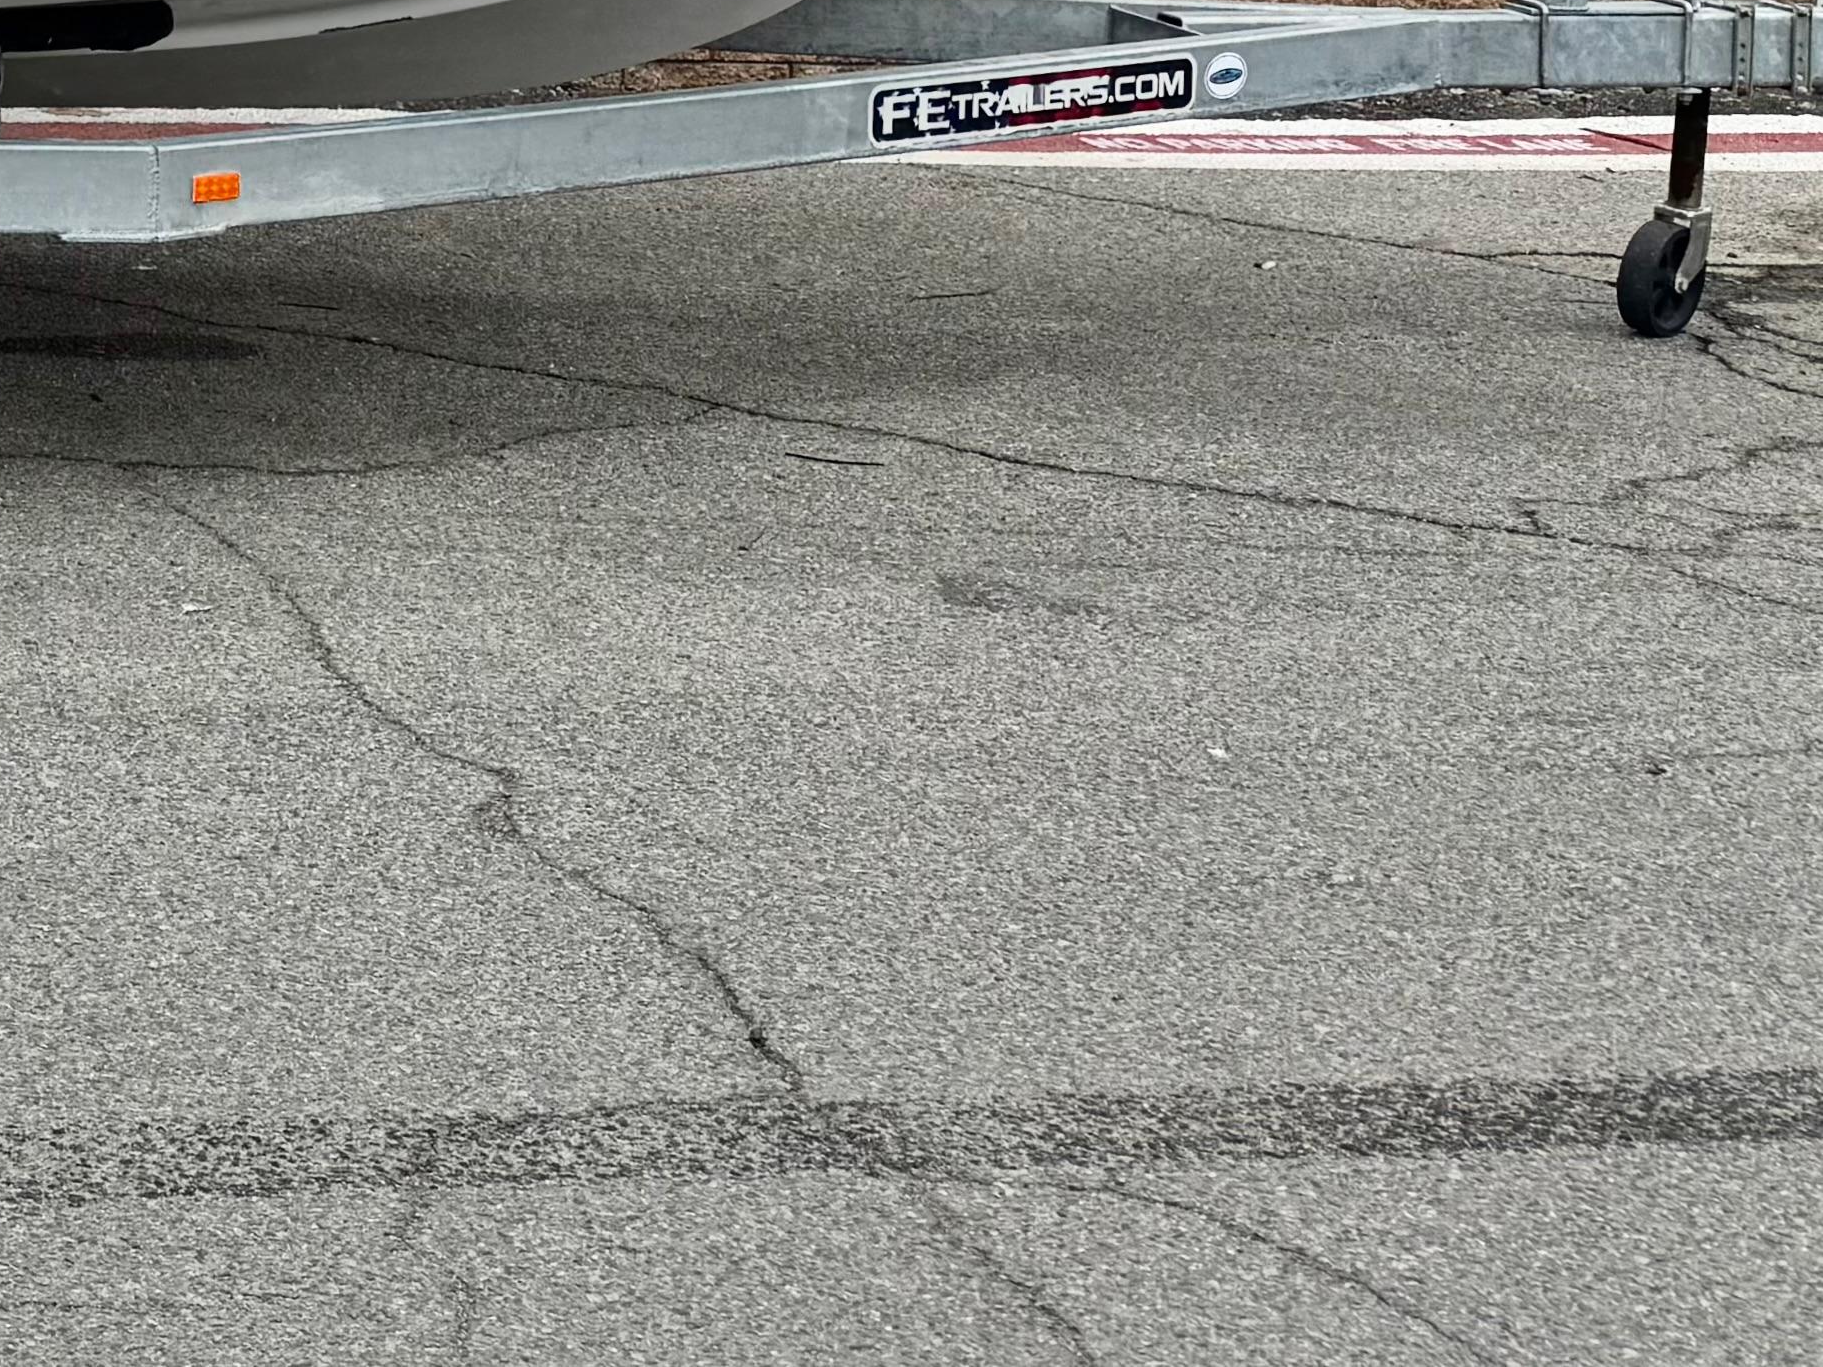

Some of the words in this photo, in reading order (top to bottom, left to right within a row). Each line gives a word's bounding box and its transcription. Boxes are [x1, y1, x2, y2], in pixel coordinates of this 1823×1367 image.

[1079, 137, 1165, 151] NO
[1156, 138, 1362, 152] PARKING
[1368, 138, 1483, 151] FIRE
[1474, 138, 1608, 151] LANE
